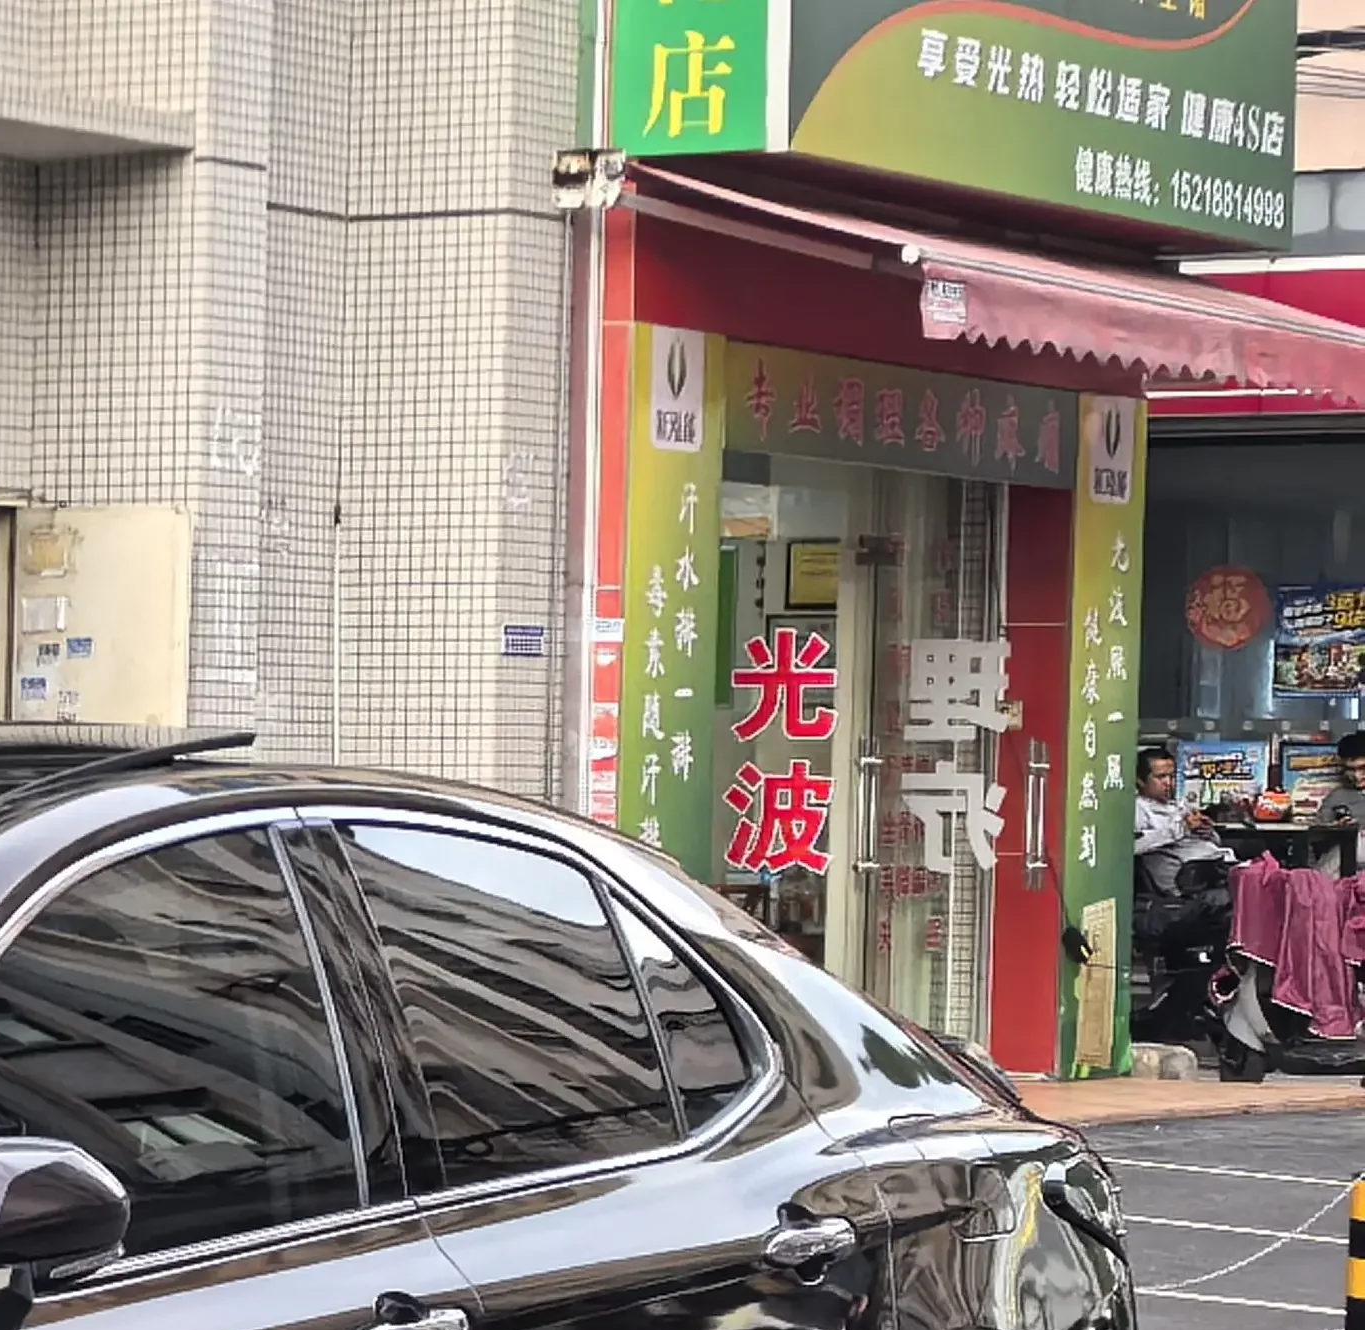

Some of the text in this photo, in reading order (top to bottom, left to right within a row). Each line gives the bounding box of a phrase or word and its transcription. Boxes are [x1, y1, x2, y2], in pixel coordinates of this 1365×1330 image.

[642, 0, 736, 138] 店
[916, 27, 1046, 104] 享受光热
[722, 627, 839, 876] 光波
